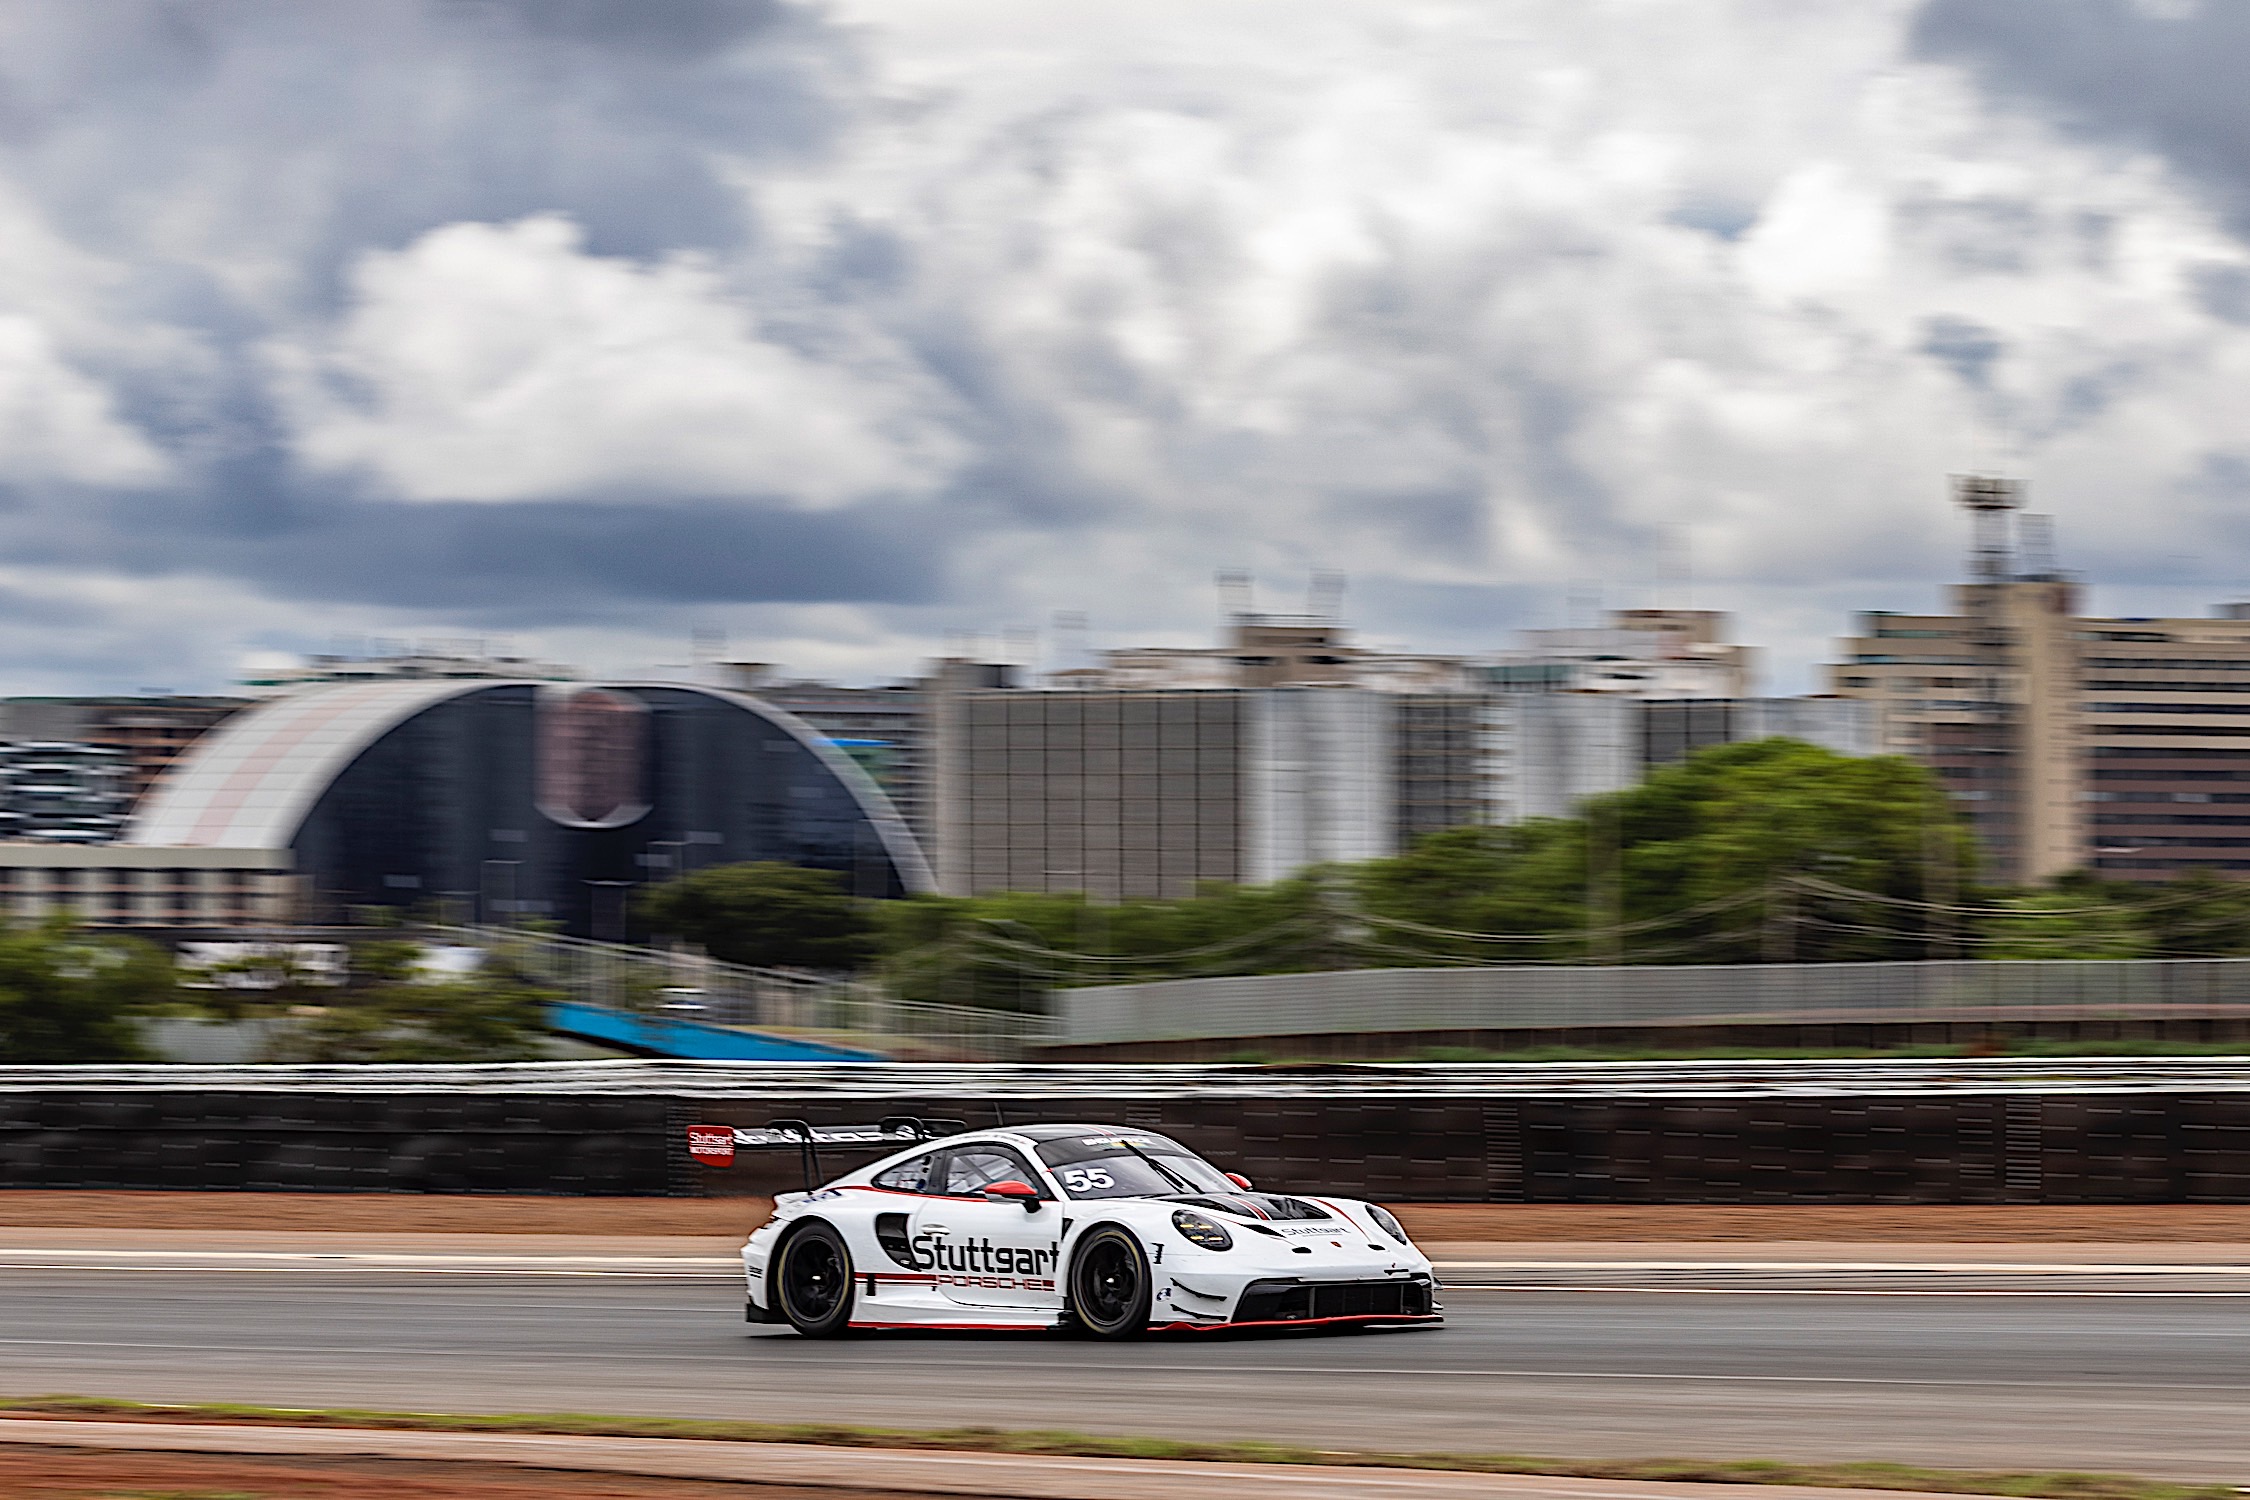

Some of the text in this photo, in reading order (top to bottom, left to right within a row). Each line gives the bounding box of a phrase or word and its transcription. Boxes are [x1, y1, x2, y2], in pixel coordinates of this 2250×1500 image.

[1063, 1168, 1115, 1192] 55
[912, 1236, 1060, 1275] Stuttgart
[936, 1275, 1044, 1291] PORSCHE
